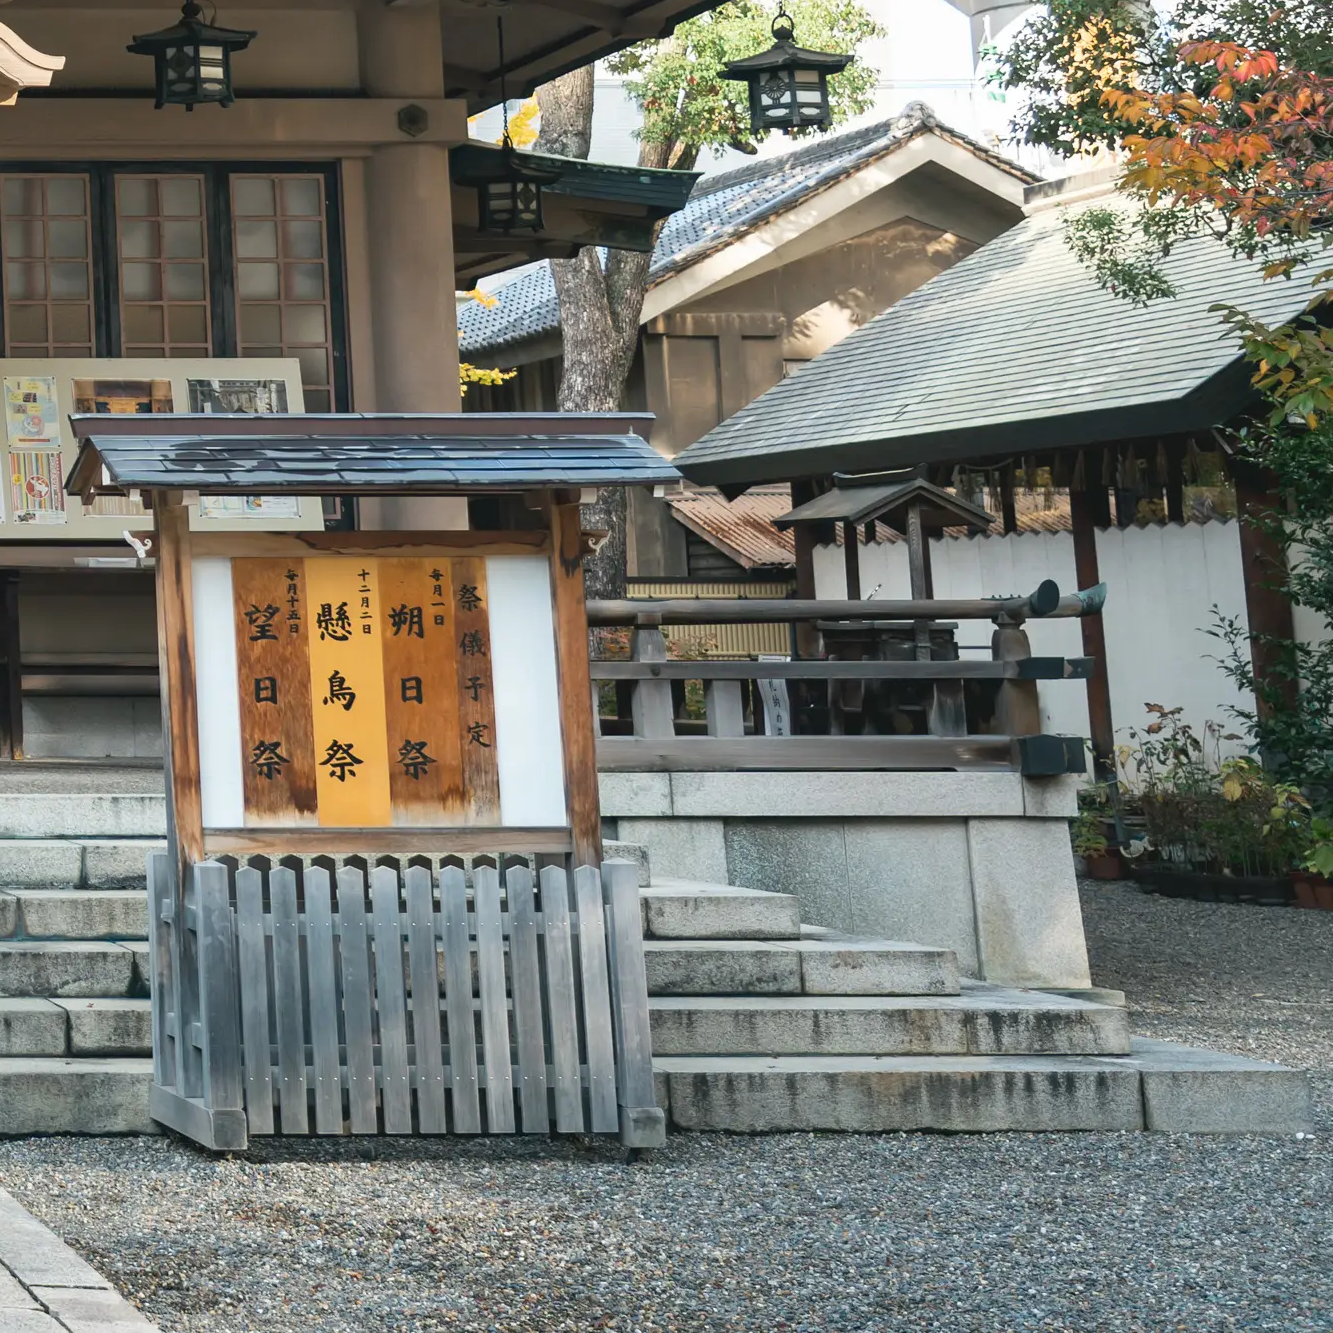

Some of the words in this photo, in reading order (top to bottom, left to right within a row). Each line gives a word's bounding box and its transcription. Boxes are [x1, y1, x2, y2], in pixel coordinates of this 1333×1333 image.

[284, 568, 301, 635] 毎月十五日
[356, 568, 372, 635] 十二月二日
[429, 568, 445, 627] 毎月一日
[457, 583, 492, 749] 祭儀予定
[243, 602, 291, 782] 望日祭
[315, 602, 364, 783] 懸鳥祭
[388, 603, 437, 781] 朔日祭
